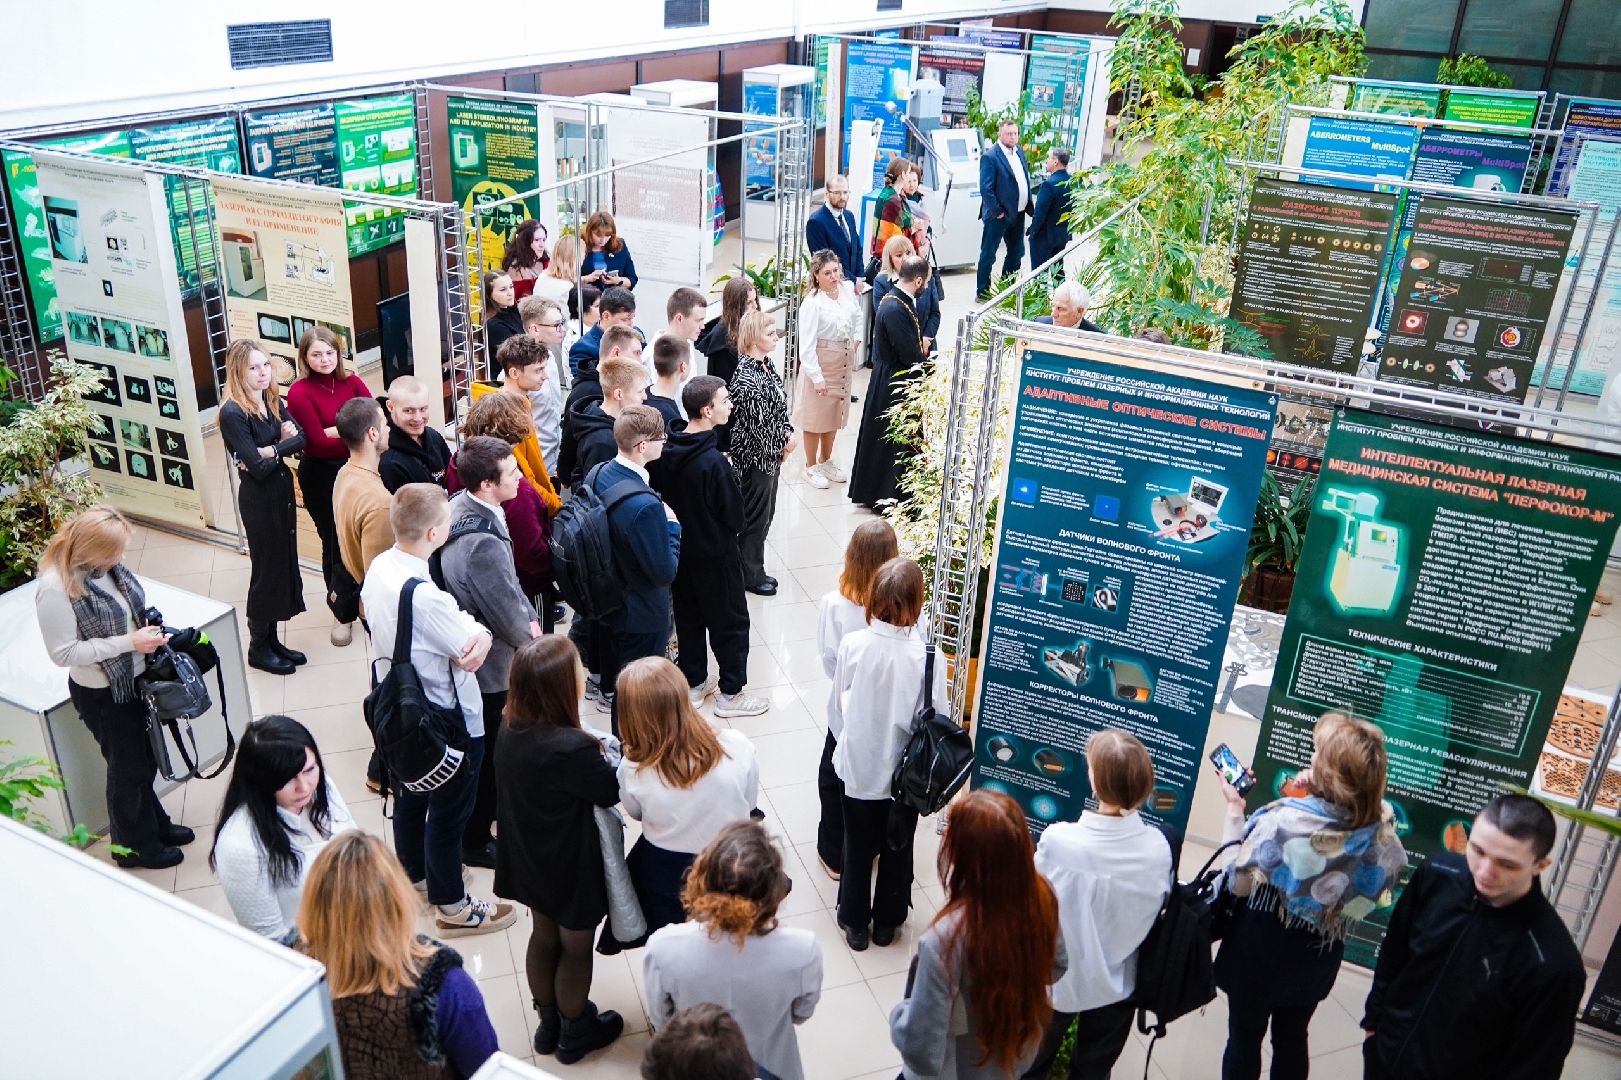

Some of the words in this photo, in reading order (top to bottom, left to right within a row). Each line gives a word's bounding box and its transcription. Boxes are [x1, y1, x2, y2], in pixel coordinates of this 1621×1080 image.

[471, 120, 503, 130] APPLICATION
[511, 124, 536, 133] INDUSTRY
[1311, 131, 1371, 144] ABERROMETERS
[1371, 142, 1410, 154] MultiSpot
[1420, 144, 1483, 158] АБЕРРОМЕТРЫ
[1481, 157, 1526, 170] MultiSpot
[1026, 369, 1061, 382] ИНСТИТУТ
[1061, 375, 1096, 389] ПРОБЛЕМ
[1096, 382, 1136, 396] ЛАЗЕРНЫХ
[1144, 390, 1220, 411] ИНФОРМАЦИОННЫХ
[1220, 404, 1271, 421] ТЕХНОЛОГИЙ
[1067, 367, 1115, 383] УЧРЕЖДЕНИЕ
[1115, 376, 1166, 393] РОССИЙСКОЙ
[1166, 385, 1207, 400] АКАДЕМИИ
[1208, 392, 1228, 404] НАУК
[1023, 385, 1109, 411] АДАПТИВНЫЕ
[1112, 401, 1197, 427] ОПТИЧЕСКИЕ
[1199, 417, 1268, 440] СИСТЕМЫ
[1337, 424, 1376, 437] ИНСТИТУТ
[1376, 431, 1414, 444] ПРОБЛЕМ
[1415, 438, 1459, 452] ЛАЗЕРНЫХ
[1467, 448, 1550, 469] ИНФОРМАЦИОННЫХ
[1551, 463, 1608, 479] ТЕХНОЛОГИЙ
[1390, 424, 1444, 439] УЧРЕЖДЕНИЕ
[1444, 433, 1500, 449] РОССИЙСКОЙ
[1500, 443, 1547, 458] АКАДЕМИИ
[1547, 452, 1570, 462] НАУК
[1327, 458, 1431, 489] МЕДИЦИНСКАЯ
[1431, 478, 1501, 502] СИСТЕМА
[1360, 448, 1506, 486] ИНТЕЛЛЕКТУАЛЬНАЯ
[1507, 475, 1587, 501] ЛАЗЕРНАЯ
[1059, 529, 1095, 545] ДАТЧИКИ
[1096, 537, 1145, 556] ВОЛНОВОГО
[1147, 548, 1181, 564] ФРОНТА
[1347, 629, 1412, 651] ТЕХНИЧЕСКИЕ
[1413, 645, 1498, 672] ХАРАКТЕРИСТИКИ
[1029, 680, 1079, 701] КОРРЕКТОРЫ
[1080, 694, 1126, 714] ВОЛНОВОГО
[1127, 708, 1159, 724] ФРОНТА
[1430, 747, 1528, 780] РЕВАСКУЛЯРИЗАЦИЯ
